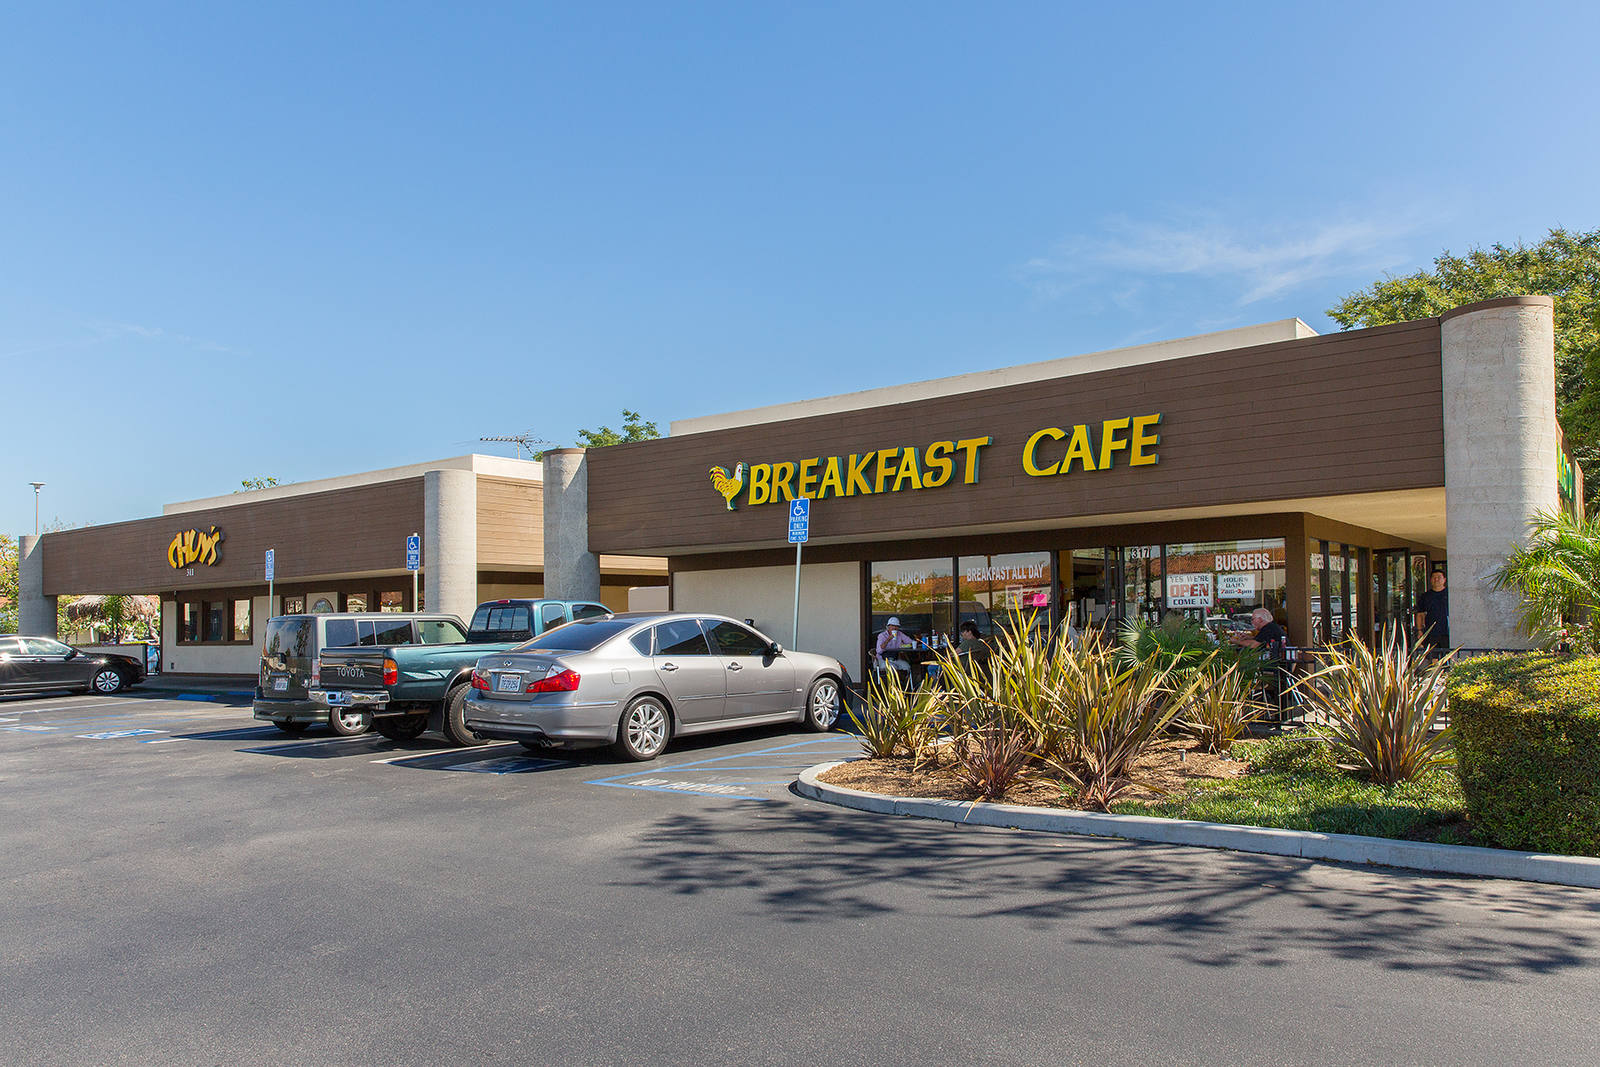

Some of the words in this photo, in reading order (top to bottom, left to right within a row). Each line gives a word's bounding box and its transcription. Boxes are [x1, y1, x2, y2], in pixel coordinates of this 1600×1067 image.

[748, 436, 991, 505] BREAKFAST
[1022, 413, 1162, 477] CAFE
[1130, 547, 1150, 559] 317
[1215, 552, 1270, 571] BURGERS
[186, 568, 195, 577] 311
[896, 571, 926, 585] LUNCH
[967, 566, 1010, 582] BREAKFAST
[1012, 564, 1027, 580] ALL
[1029, 563, 1045, 579] DAY
[1170, 584, 1209, 597] OPEN
[336, 667, 365, 678] TOYOTA
